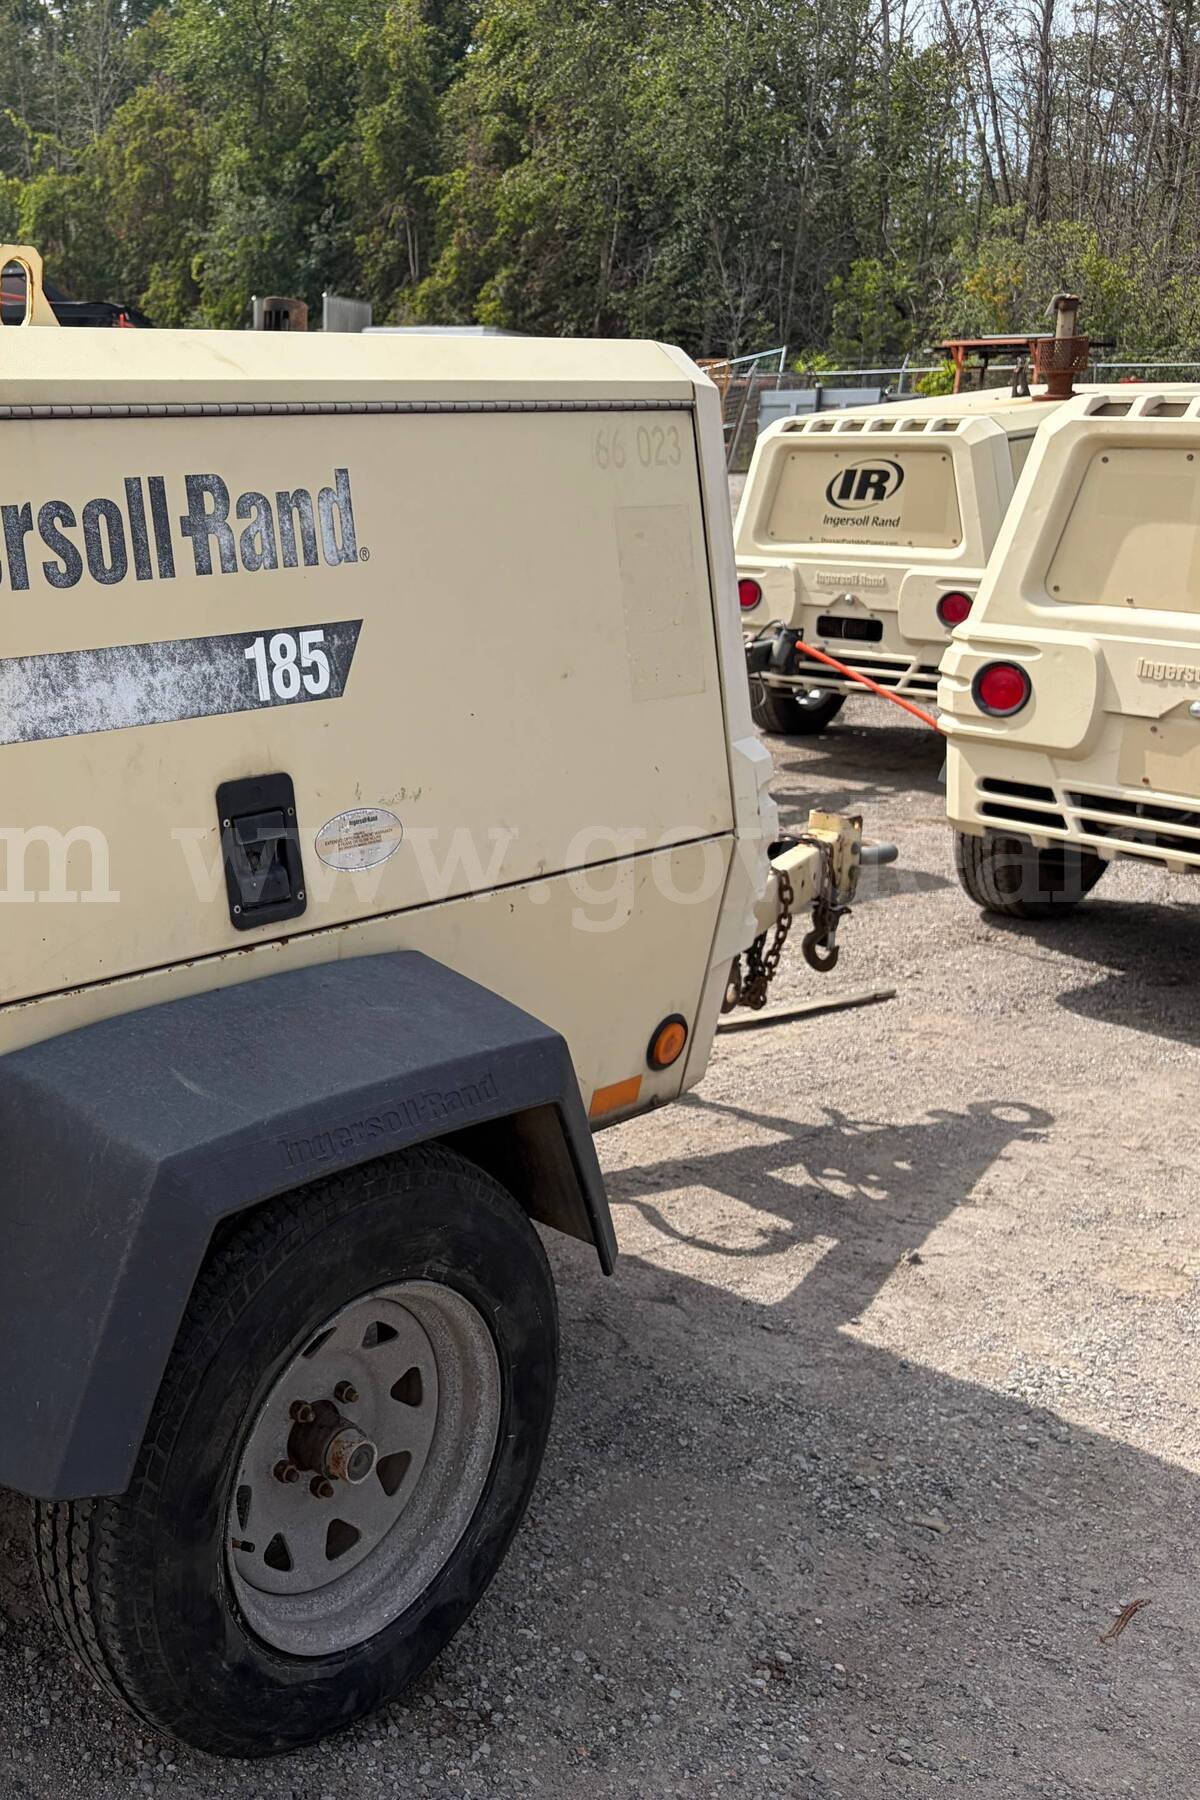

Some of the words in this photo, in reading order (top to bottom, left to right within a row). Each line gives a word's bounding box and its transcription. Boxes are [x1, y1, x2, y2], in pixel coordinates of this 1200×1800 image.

[637, 424, 682, 468] 023
[837, 469, 891, 501] IR
[823, 514, 870, 528] Ingersoll
[871, 515, 901, 528] Rand
[244, 629, 331, 701] 185
